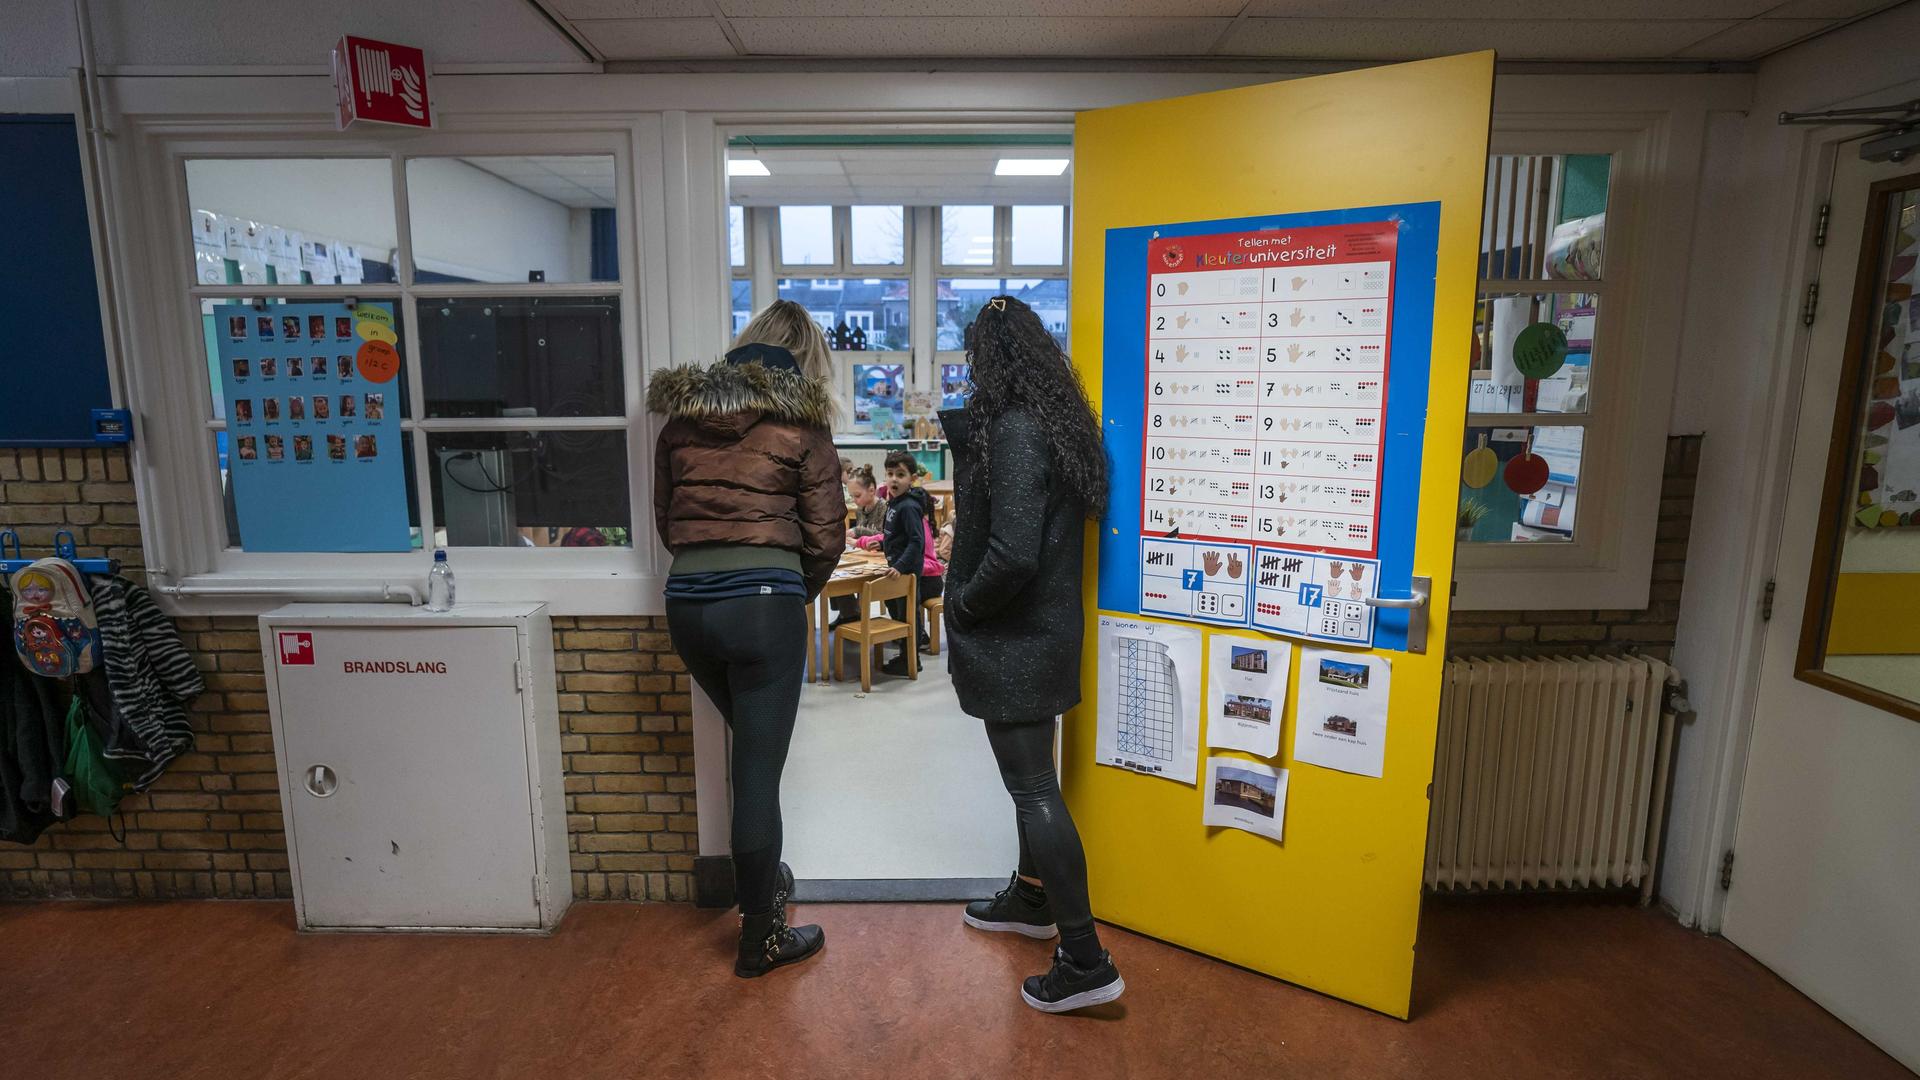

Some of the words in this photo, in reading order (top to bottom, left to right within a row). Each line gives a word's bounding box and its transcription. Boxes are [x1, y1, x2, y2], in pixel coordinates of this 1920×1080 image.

[1238, 237, 1268, 248] Tellen
[1271, 235, 1292, 246] met
[1196, 244, 1336, 268] Kleuteruniversiteit
[1156, 283, 1166, 297] 0
[1156, 316, 1165, 331] 2
[1268, 313, 1278, 327] 3
[370, 328, 379, 336] in
[1155, 349, 1165, 363] 4
[1266, 348, 1277, 363] 5
[1154, 382, 1163, 396] 6
[1266, 382, 1275, 397] 7
[1474, 384, 1483, 393] 27
[1499, 385, 1508, 395] 29
[1153, 414, 1162, 428] 8
[1264, 417, 1273, 431] 9
[1151, 446, 1165, 460] 10
[1263, 451, 1272, 466] 11
[1150, 478, 1164, 492] 12
[1260, 485, 1274, 499] 13
[1149, 509, 1163, 524] 14
[1258, 518, 1273, 533] 15
[1185, 571, 1197, 588] 7
[1301, 586, 1319, 605] 17
[344, 661, 447, 673] BRANDSLANG
